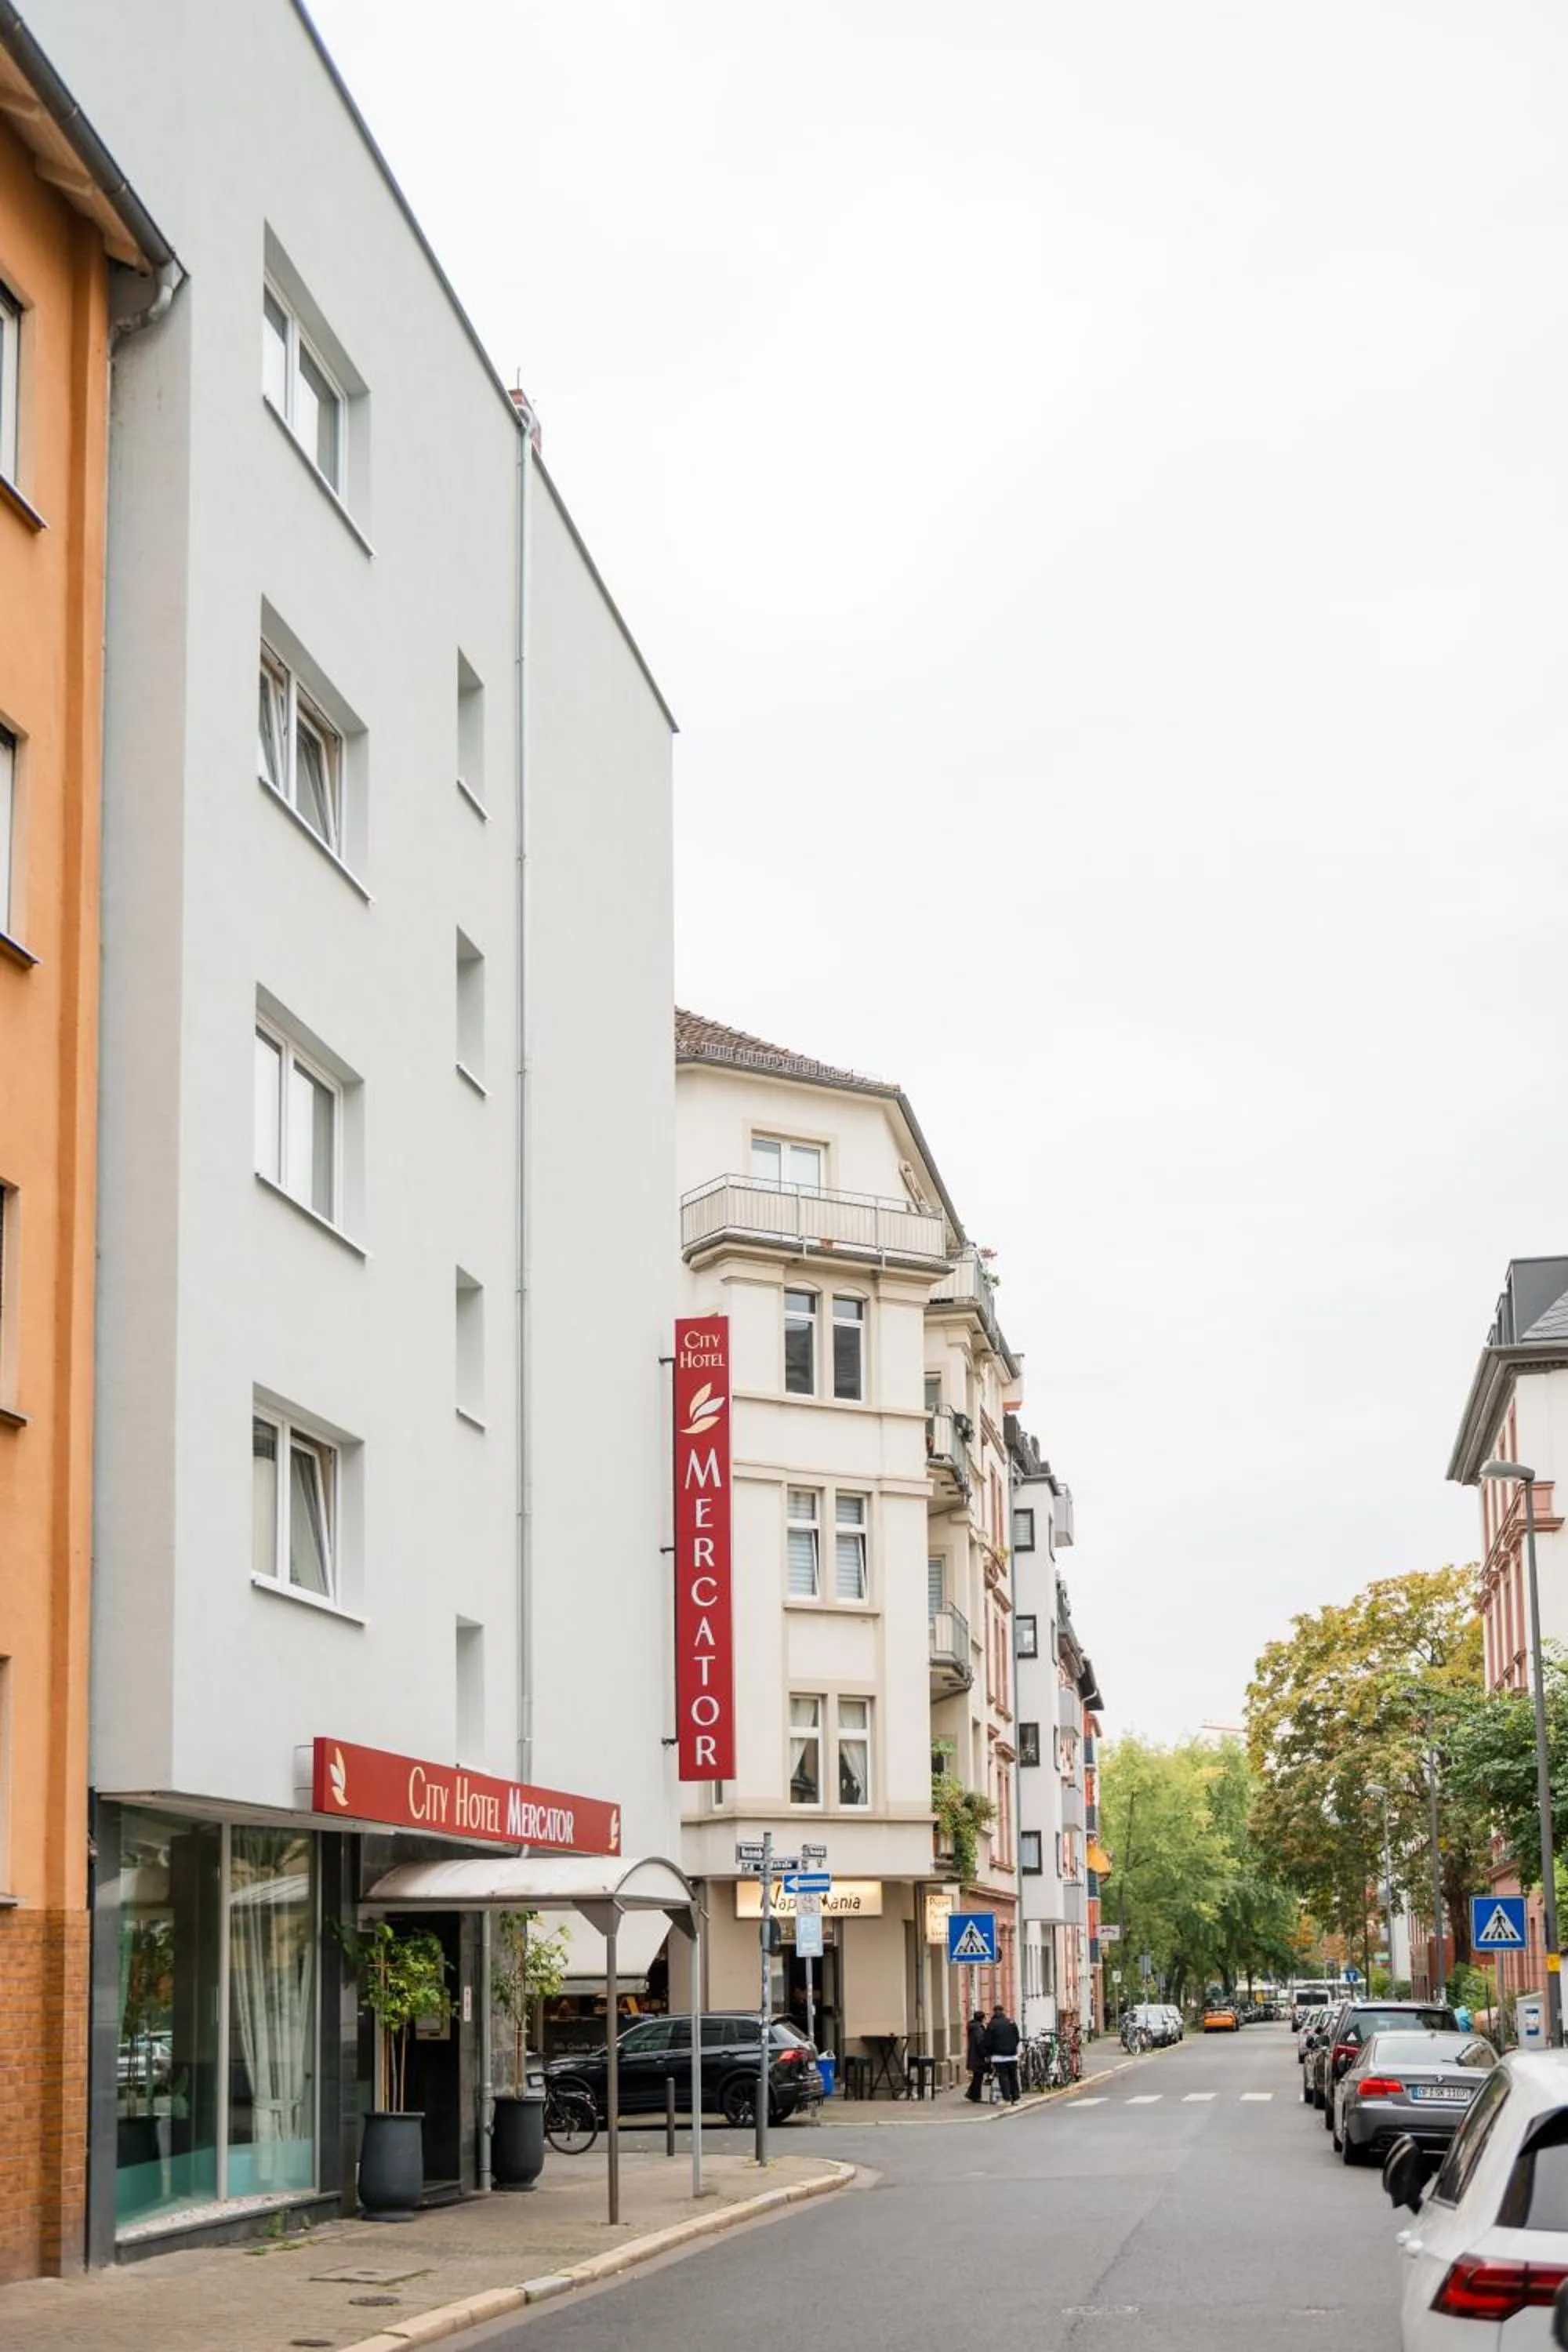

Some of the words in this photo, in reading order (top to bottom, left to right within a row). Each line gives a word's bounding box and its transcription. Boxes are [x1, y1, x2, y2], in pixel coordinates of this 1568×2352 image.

[680, 1351, 725, 1369] HOTEL
[684, 1447, 721, 1766] MERCATOR
[456, 1775, 501, 1834] HOTEL
[506, 1787, 574, 1845] MERCATOR
